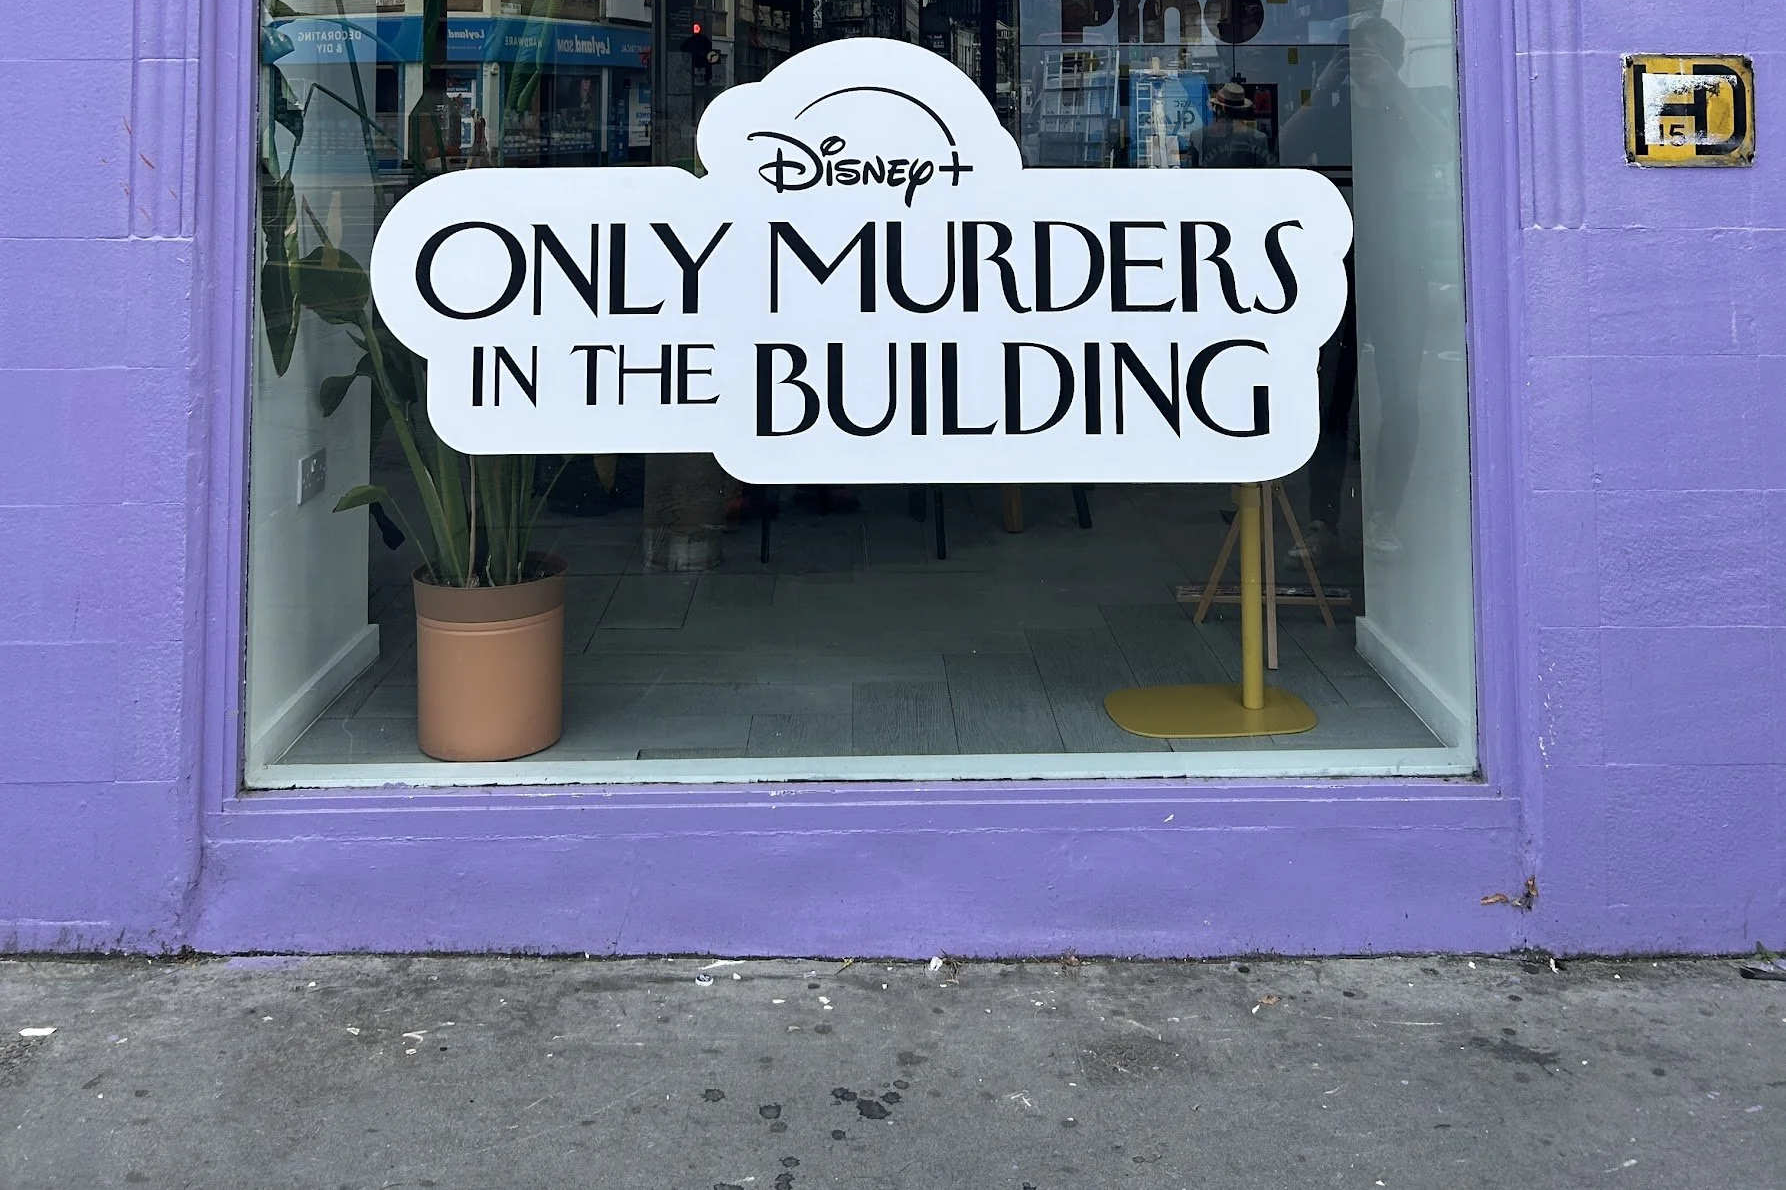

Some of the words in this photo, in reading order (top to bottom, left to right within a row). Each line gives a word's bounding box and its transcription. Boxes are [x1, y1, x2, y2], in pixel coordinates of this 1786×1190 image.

[415, 221, 733, 320] ONLY
[768, 220, 1305, 315] MURDERS
[472, 345, 538, 408] IN
[570, 344, 720, 406] THE
[754, 339, 1271, 439] BUILDING
